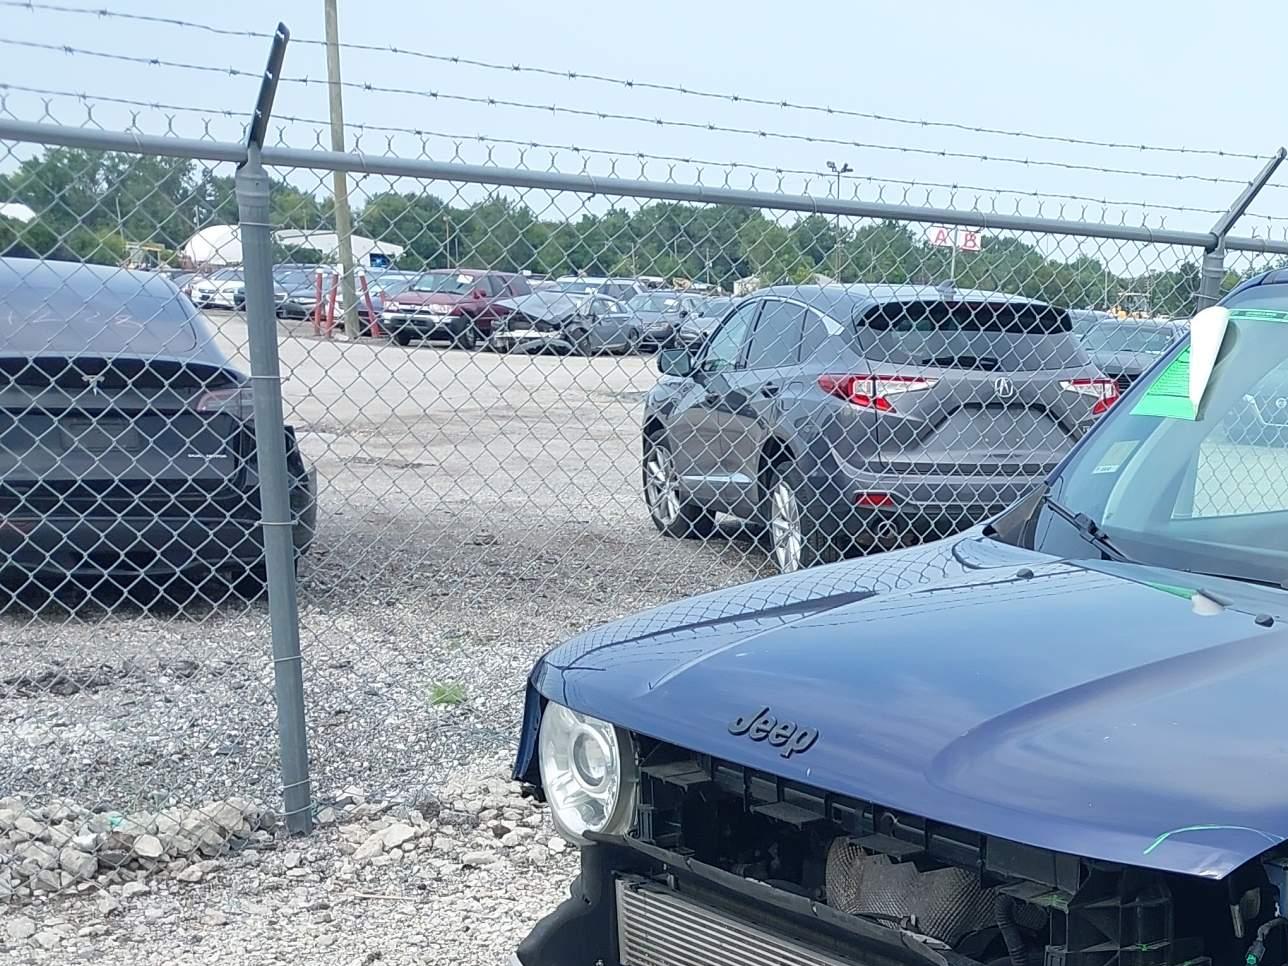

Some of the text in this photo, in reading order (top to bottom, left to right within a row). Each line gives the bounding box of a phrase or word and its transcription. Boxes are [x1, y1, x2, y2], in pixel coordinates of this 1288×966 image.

[935, 229, 947, 244] A
[964, 233, 977, 248] B
[728, 706, 819, 758] Jeep
